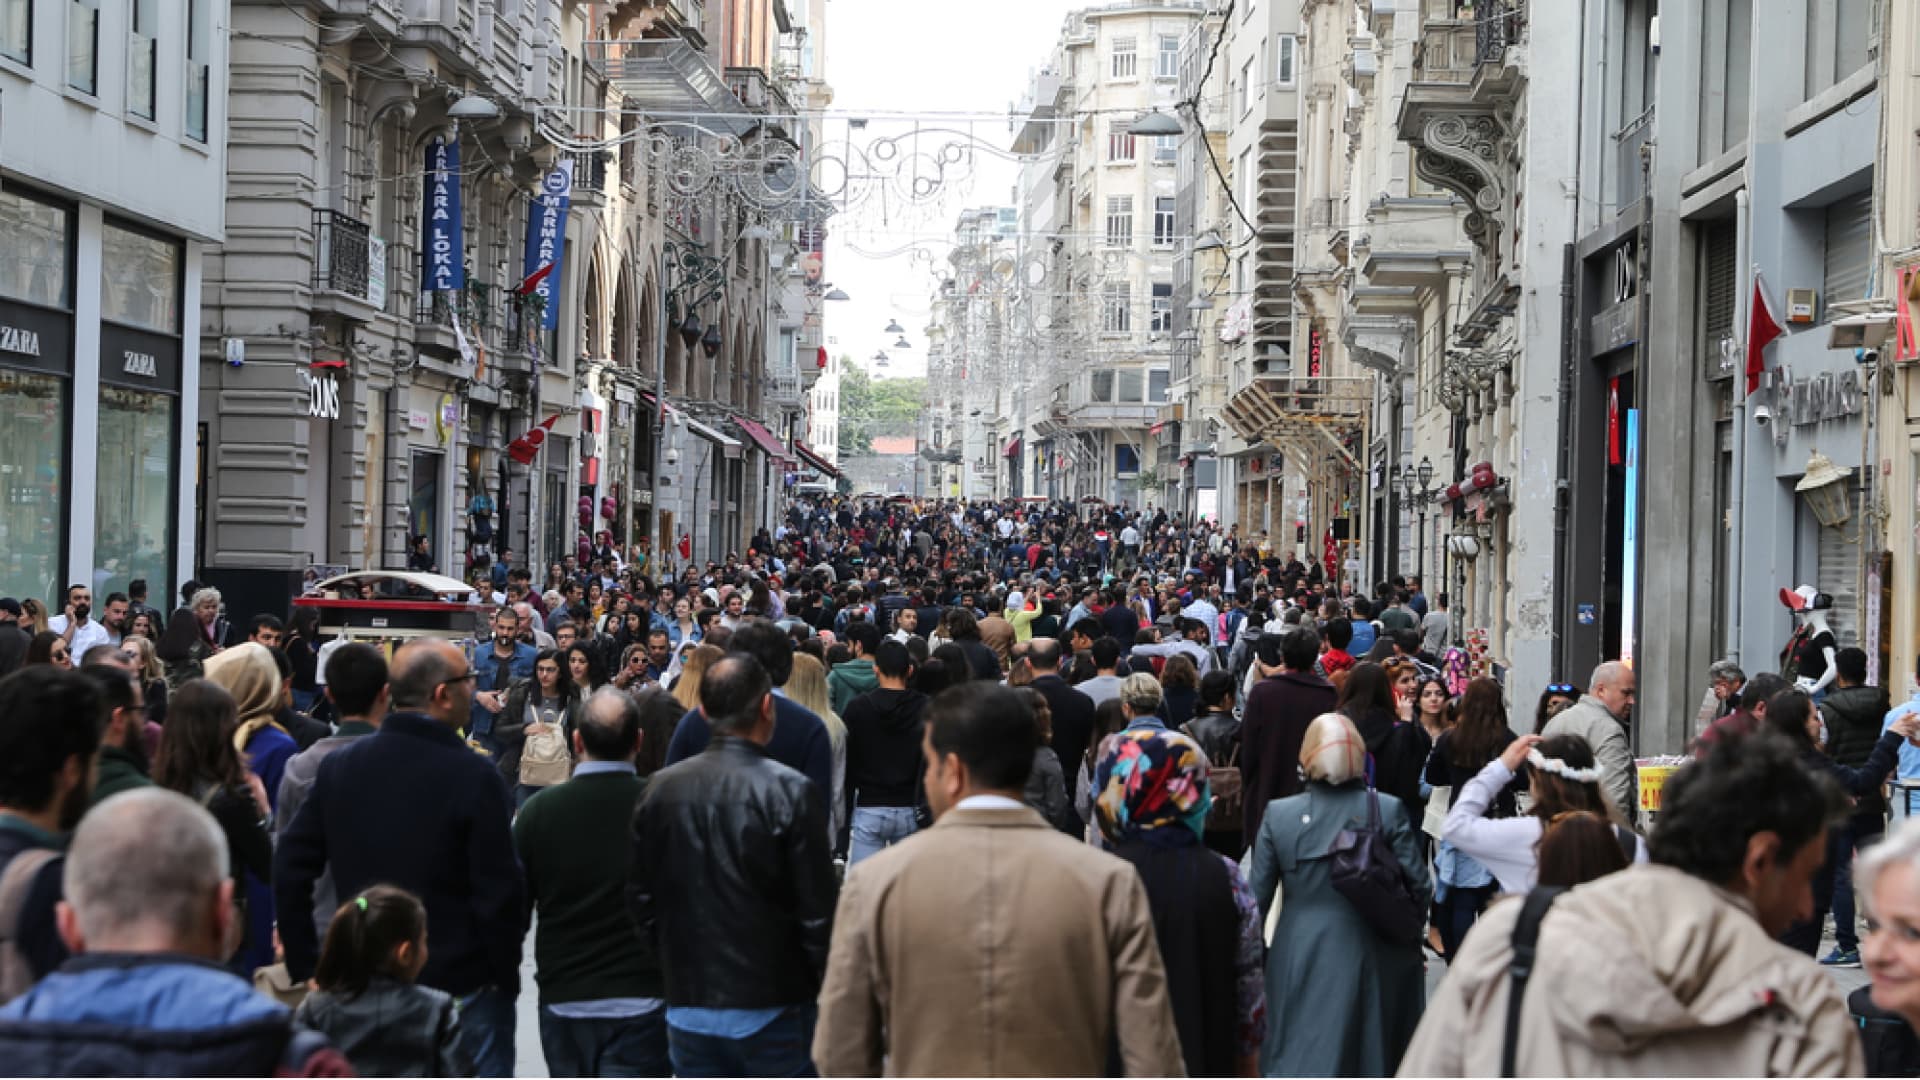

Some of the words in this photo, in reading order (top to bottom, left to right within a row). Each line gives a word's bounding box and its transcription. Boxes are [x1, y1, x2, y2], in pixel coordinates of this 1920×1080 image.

[433, 228, 452, 289] LOKAL
[0, 326, 40, 356] ZARA
[123, 351, 157, 377] ZARA
